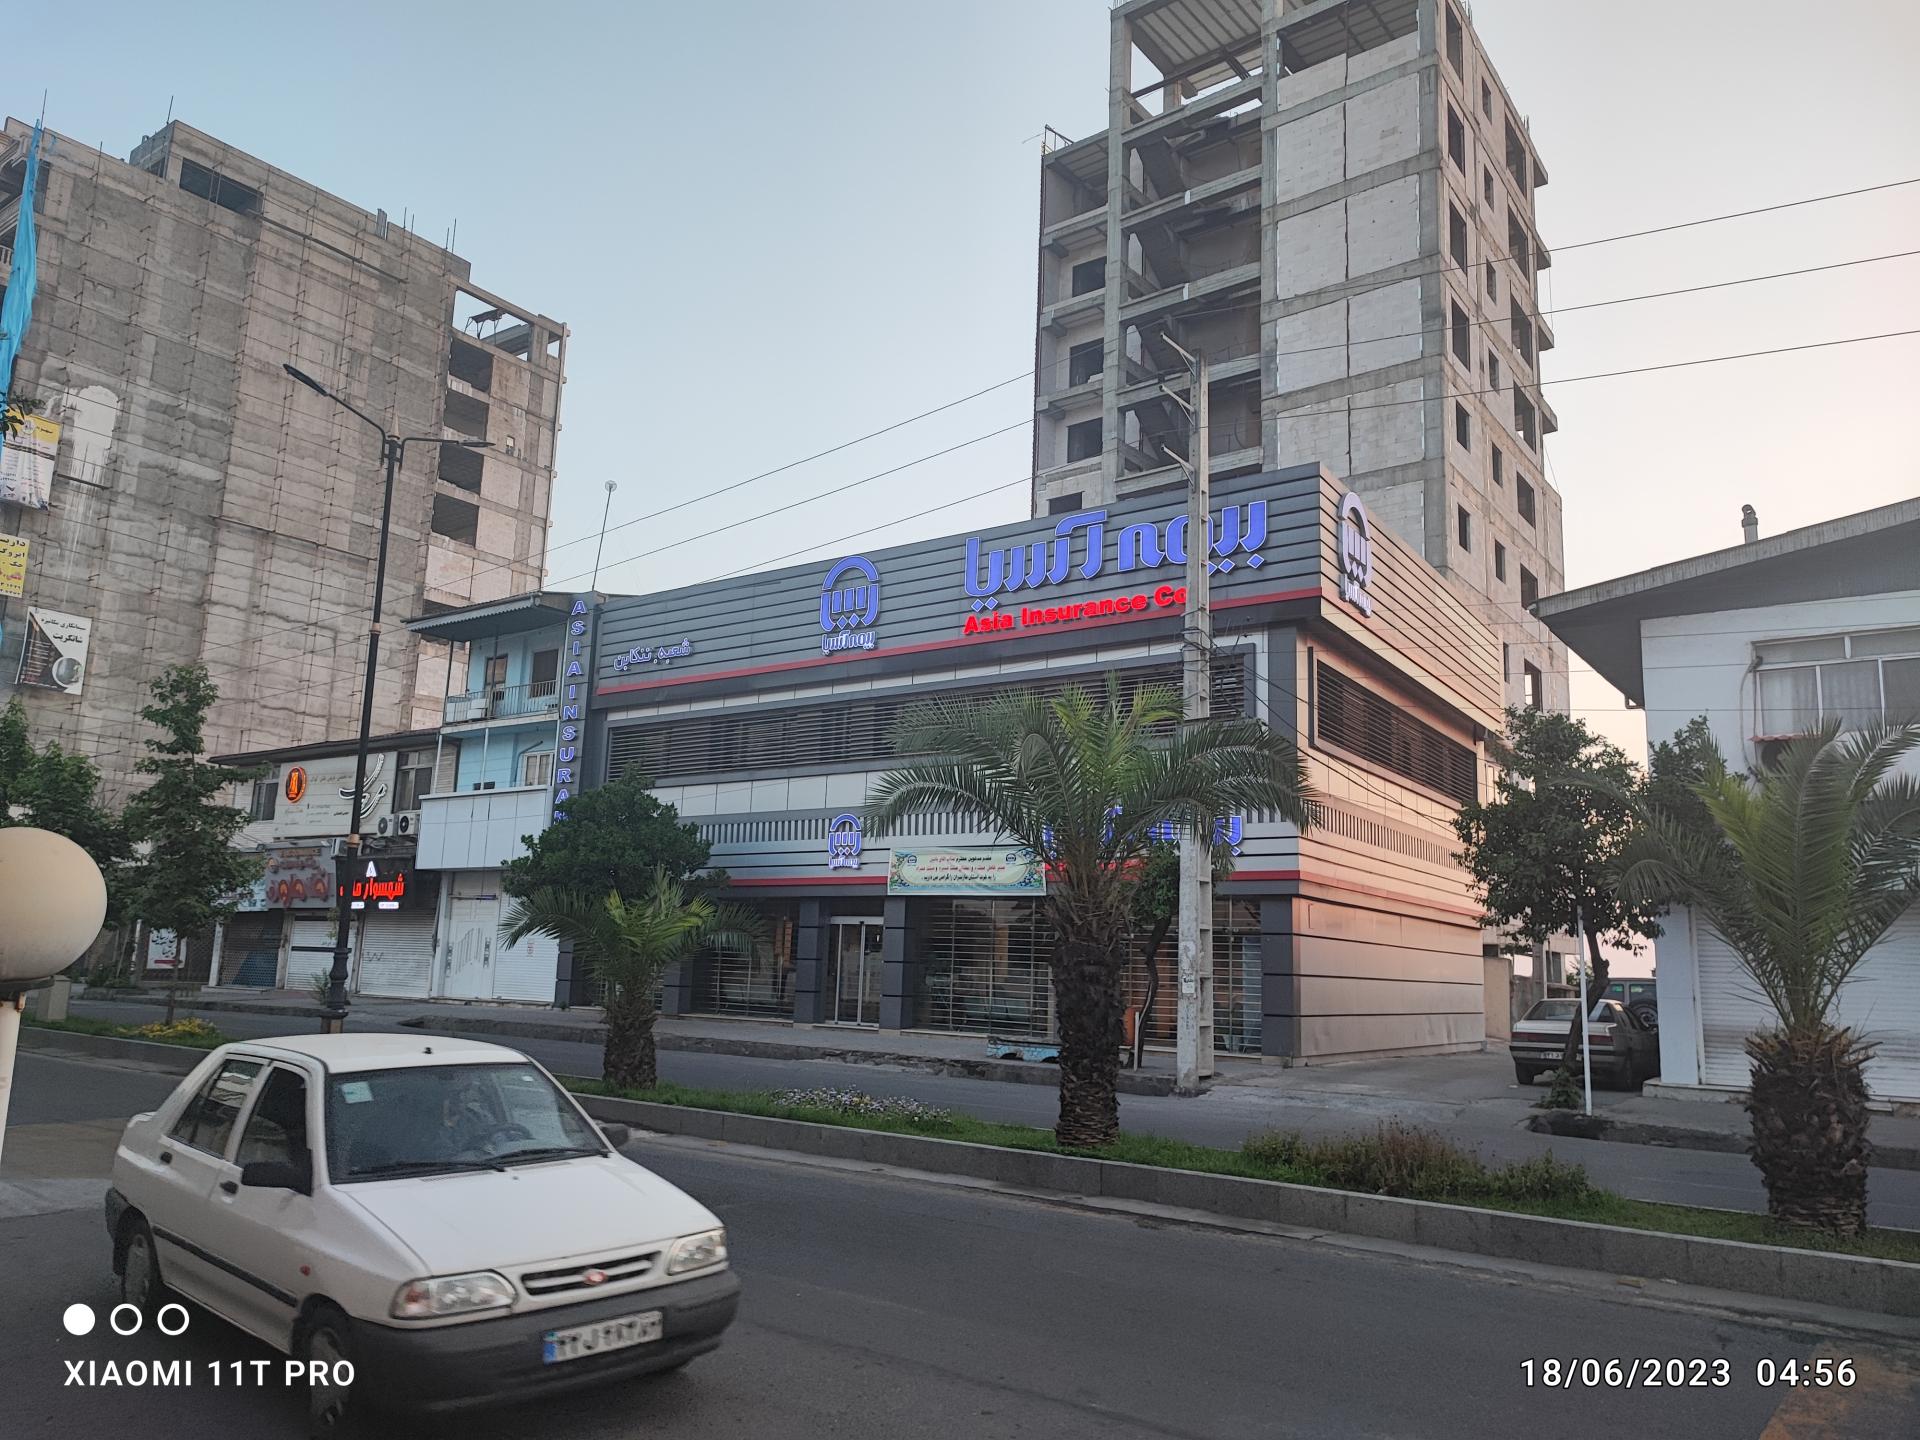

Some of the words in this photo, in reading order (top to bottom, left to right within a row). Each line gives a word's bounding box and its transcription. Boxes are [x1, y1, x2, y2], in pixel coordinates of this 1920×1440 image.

[1117, 499, 1268, 576] بیمه
[963, 508, 1108, 613] آسیا
[962, 611, 1014, 636] Asia
[1021, 593, 1148, 627] Insurance
[653, 637, 692, 664] شعبه
[821, 629, 850, 656] آسیا
[849, 631, 878, 650] بیمه
[613, 646, 652, 671] تنکابن
